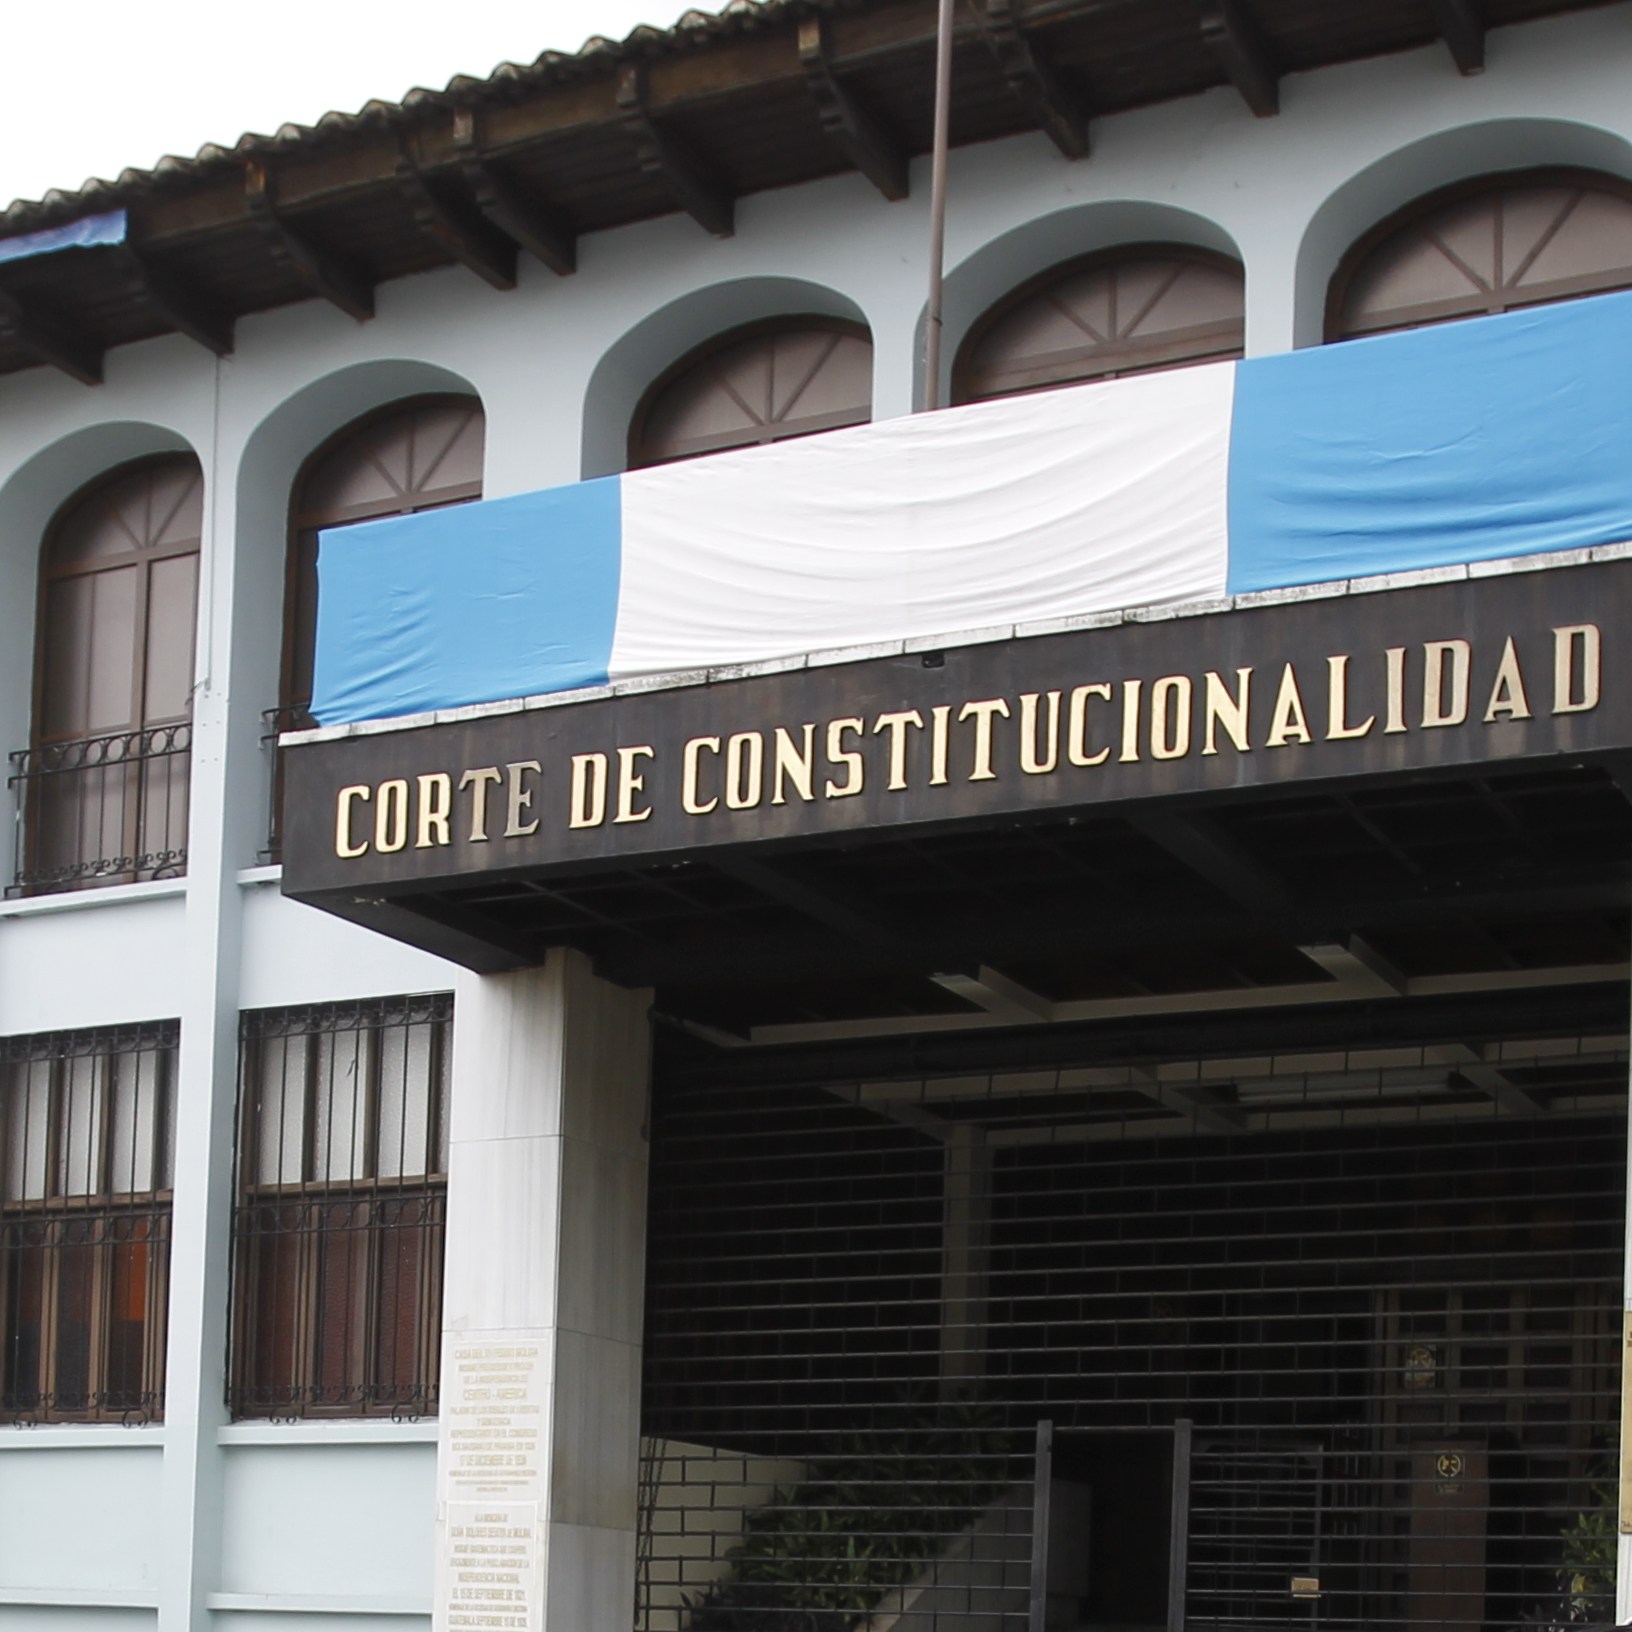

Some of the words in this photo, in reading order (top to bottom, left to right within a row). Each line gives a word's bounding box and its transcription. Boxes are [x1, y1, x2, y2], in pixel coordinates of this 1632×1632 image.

[334, 760, 544, 860] CORTE
[568, 744, 656, 830] DE
[681, 622, 1602, 815] CONSTITUCIONALIDAD
